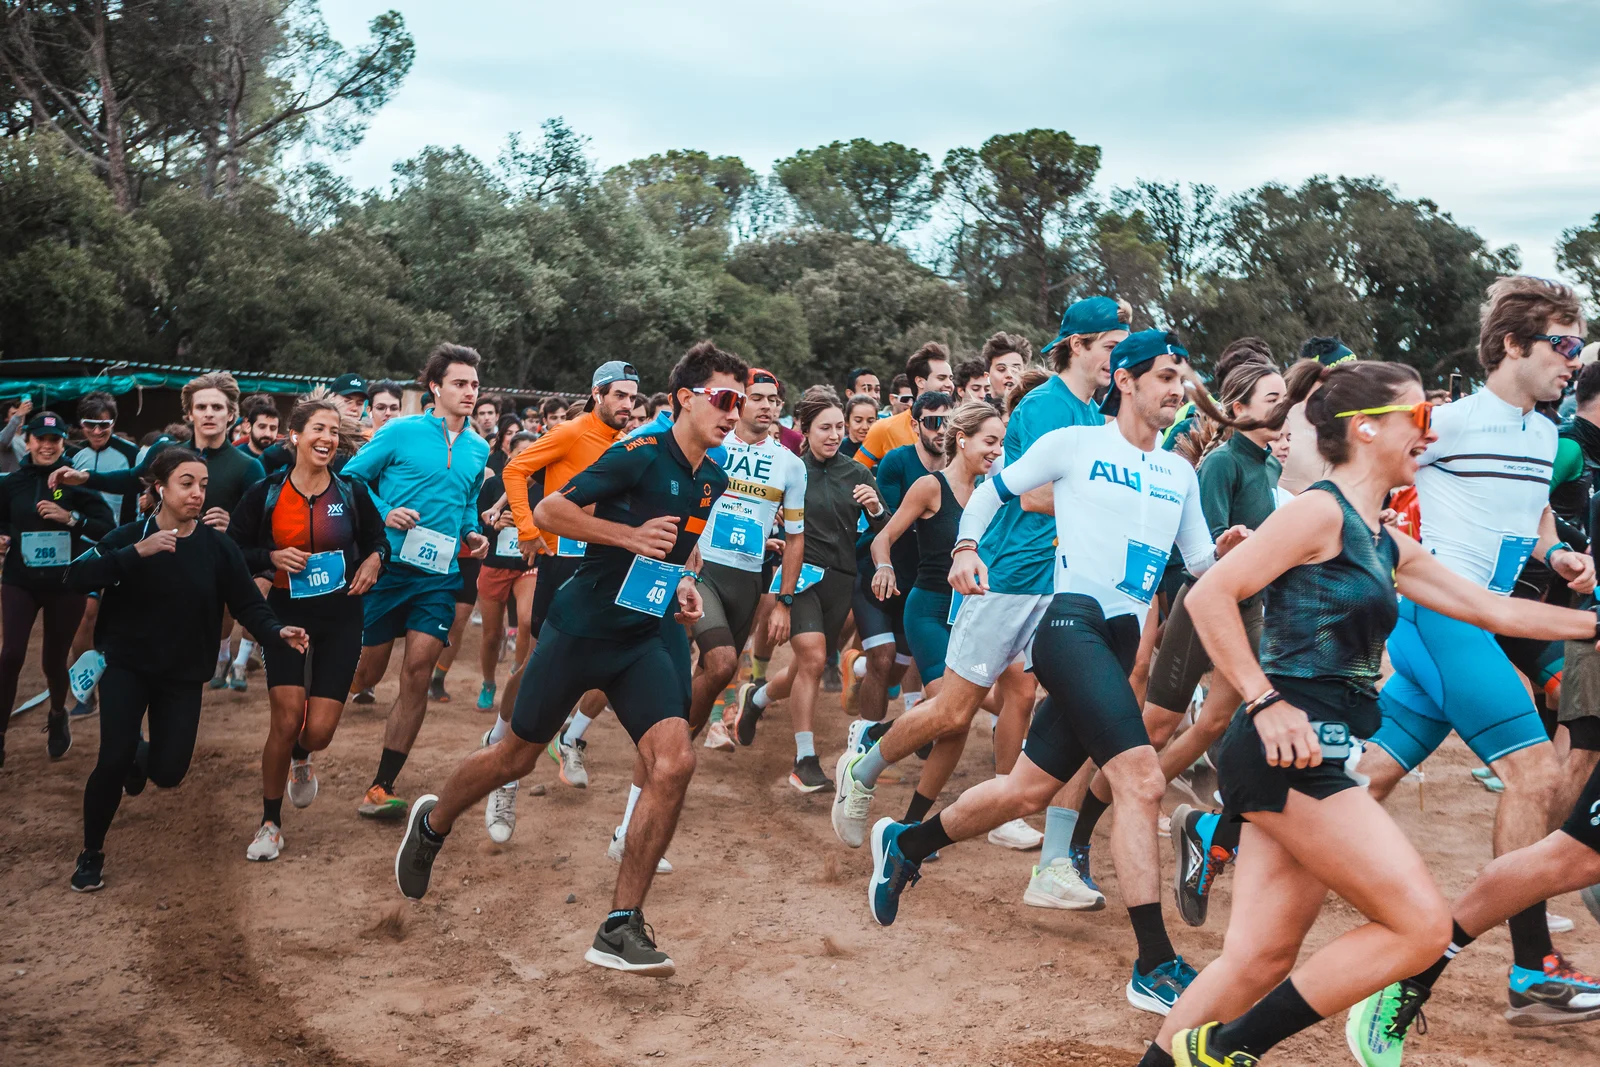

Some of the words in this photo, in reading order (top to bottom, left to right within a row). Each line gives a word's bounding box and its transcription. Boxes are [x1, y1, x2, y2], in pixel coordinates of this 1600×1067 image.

[730, 531, 746, 546] 63
[34, 547, 56, 559] 268
[417, 546, 438, 562] 231
[306, 571, 330, 587] 106
[796, 577, 806, 589] 2
[646, 586, 666, 605] 49
[77, 669, 94, 691] 219
